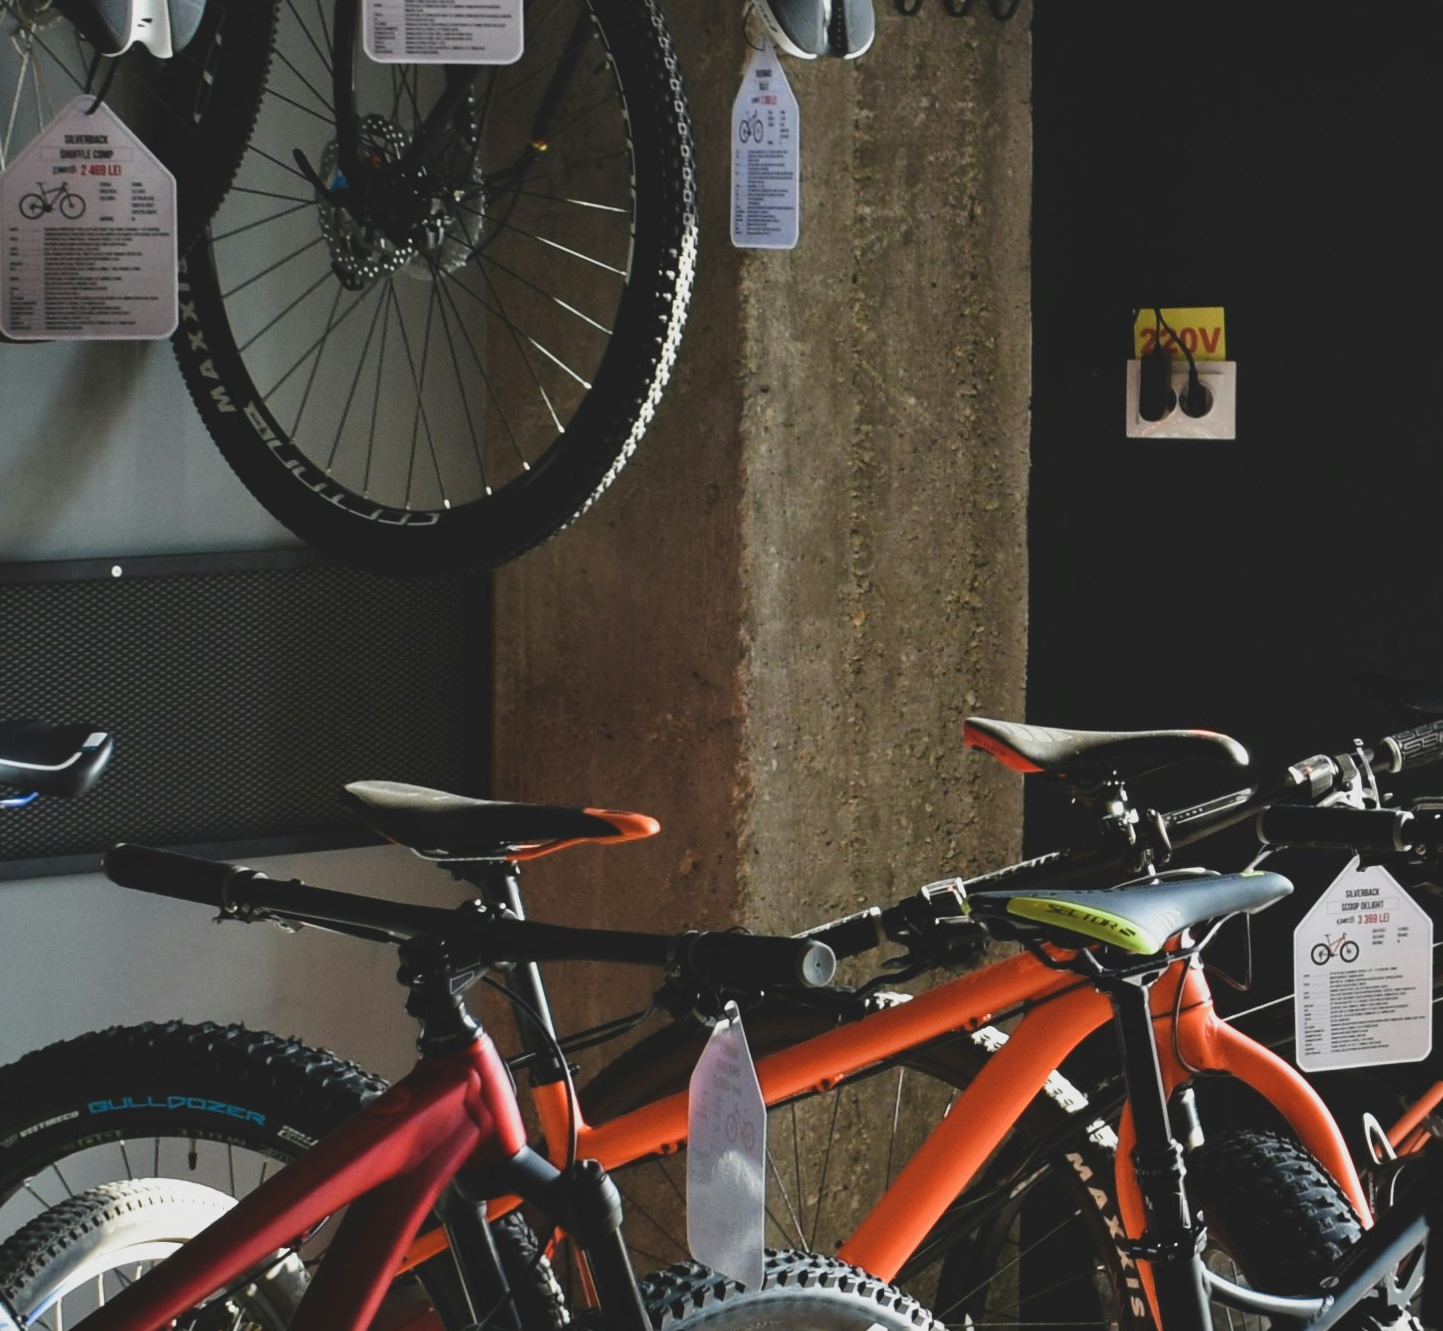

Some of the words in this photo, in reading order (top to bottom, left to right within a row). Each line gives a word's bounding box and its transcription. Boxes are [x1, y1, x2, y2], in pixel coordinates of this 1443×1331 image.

[1140, 327, 1222, 355] 220V
[1341, 902, 1360, 912] SCOOP
[1360, 900, 1385, 910] DELIGHT
[1345, 887, 1381, 899] SILVERBACK
[1046, 902, 1118, 930] SECTOR
[1379, 912, 1391, 923] LEI
[87, 1095, 266, 1126] BULLDOZER
[1064, 1151, 1146, 1318] MAXXIS
